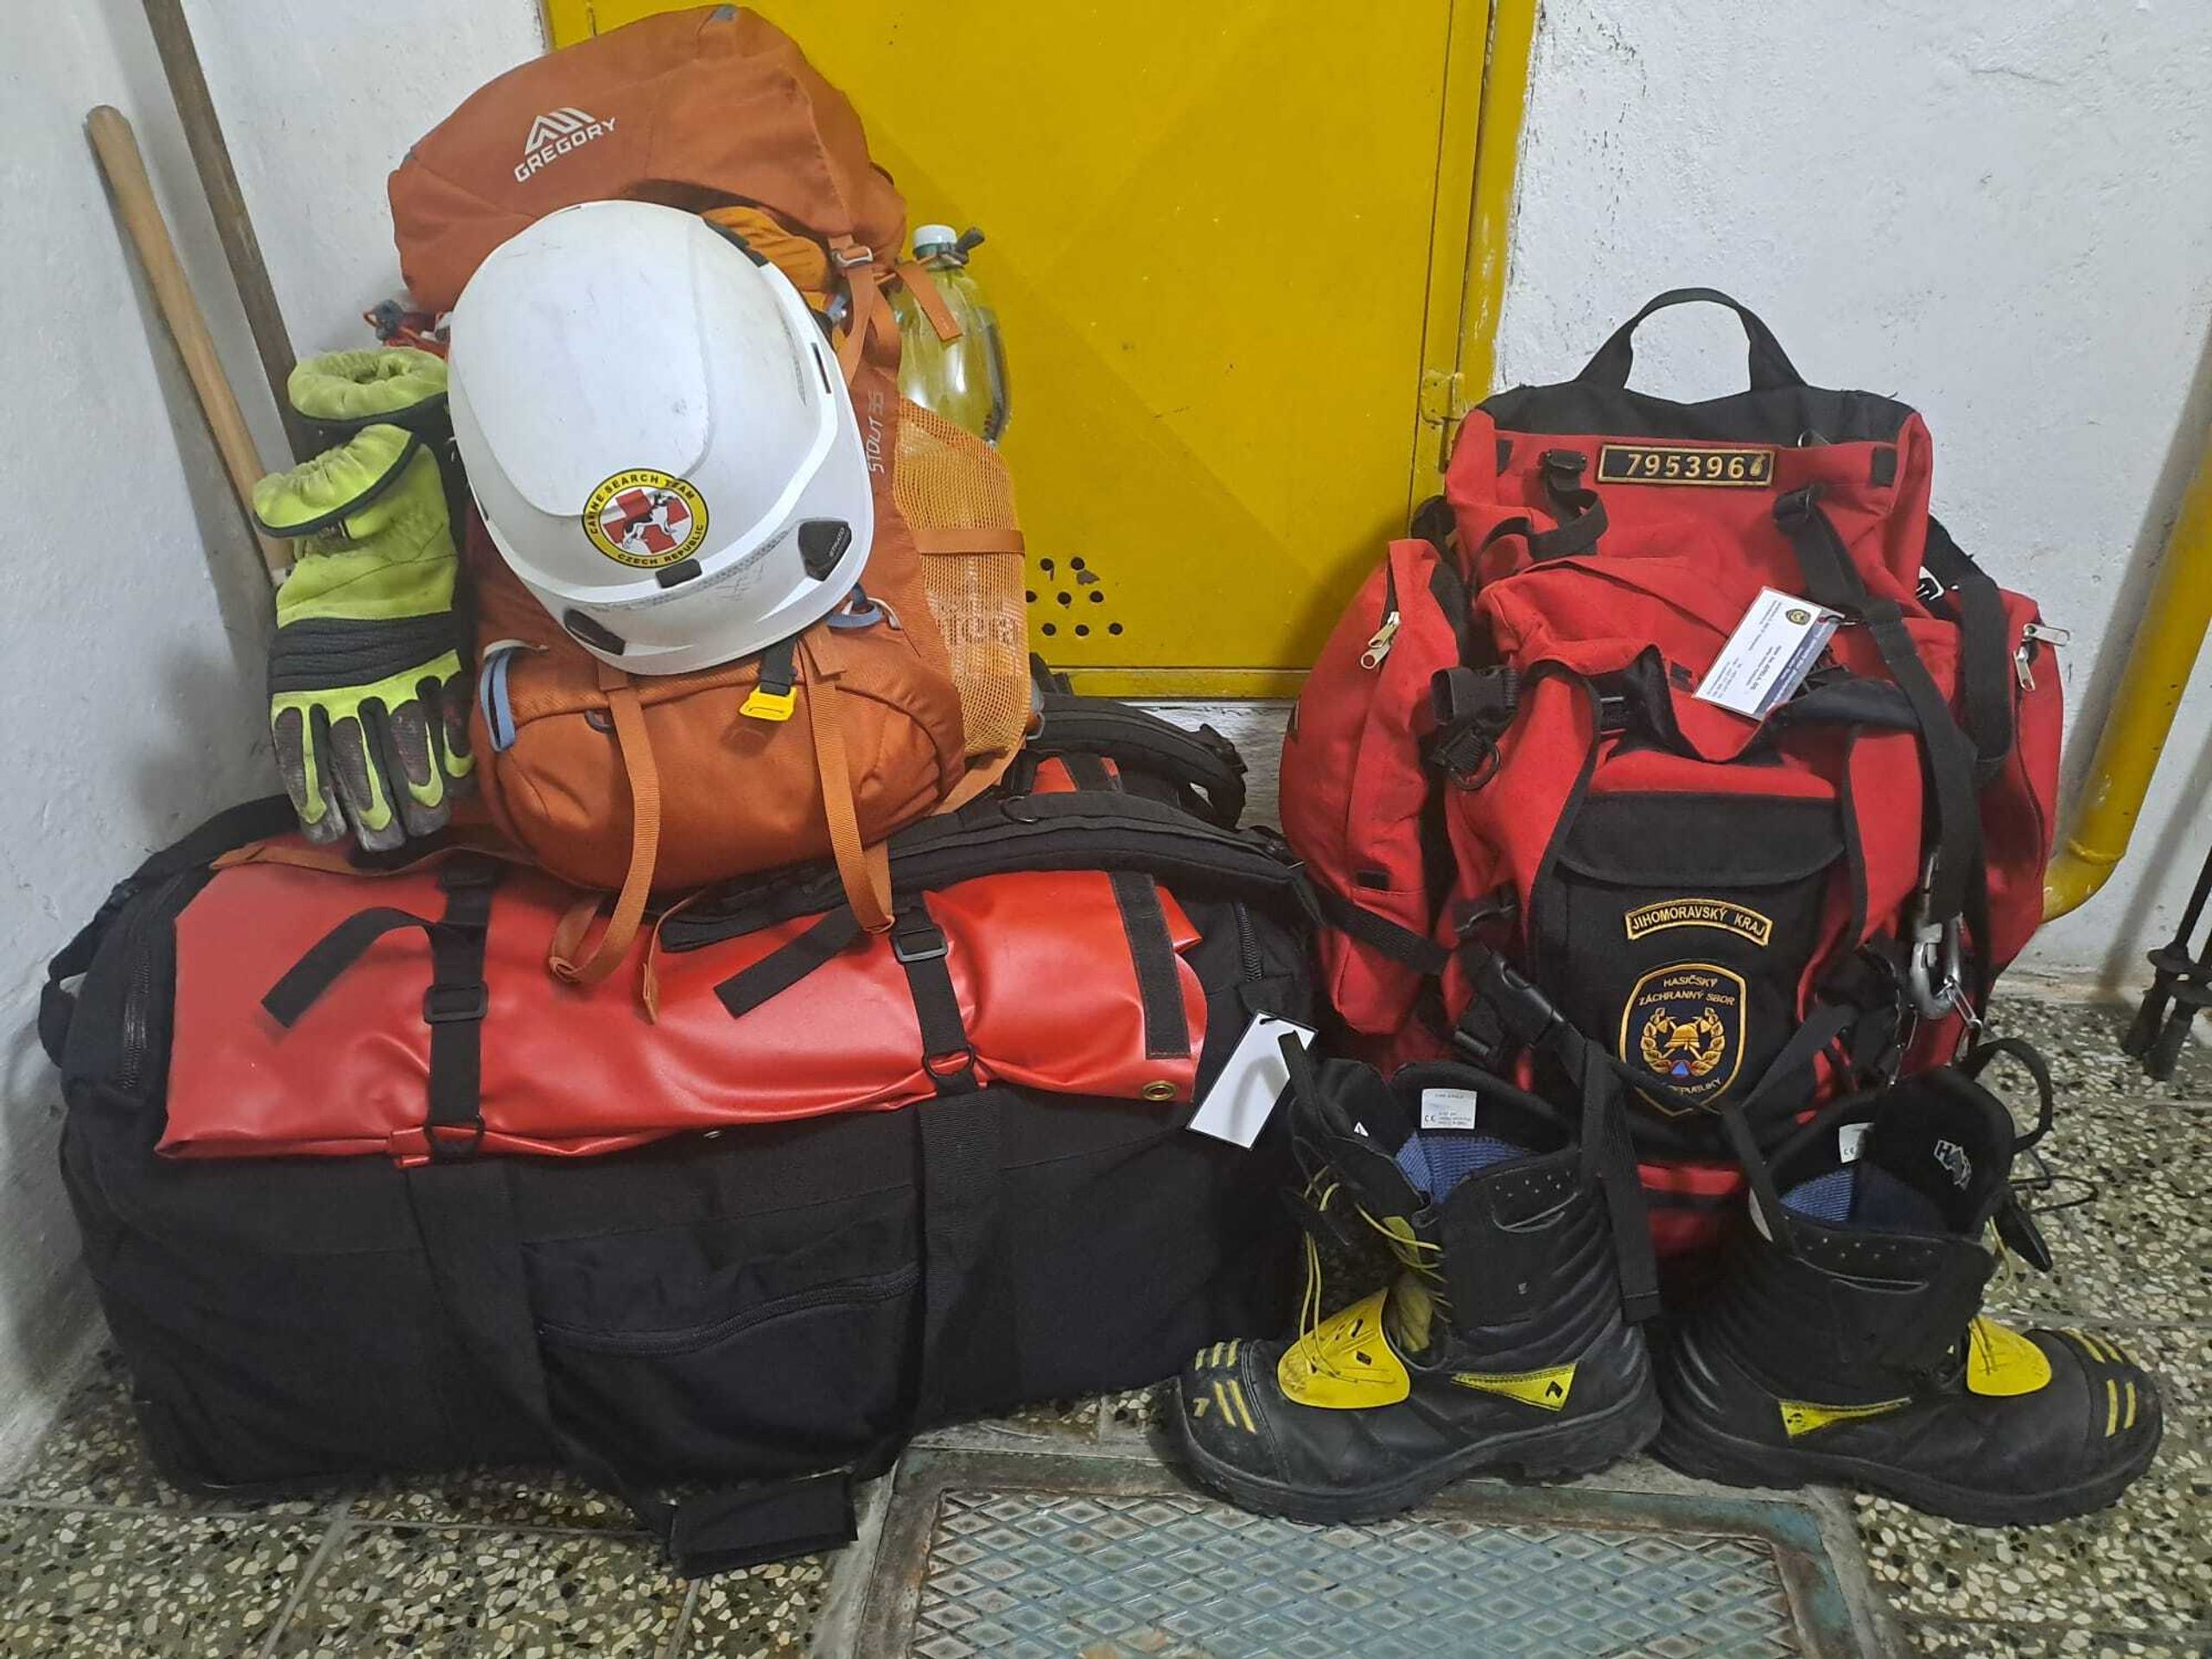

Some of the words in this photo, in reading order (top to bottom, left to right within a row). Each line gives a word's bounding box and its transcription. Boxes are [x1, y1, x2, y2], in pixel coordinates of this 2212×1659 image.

[514, 117, 616, 182] GREGORY
[866, 415, 885, 474] STOUT
[588, 494, 605, 535] CANINE
[604, 473, 659, 494] SEARCH
[664, 479, 696, 500] TEAM
[617, 553, 658, 565] CZECH
[663, 524, 704, 563] REPUBLIC
[1632, 905, 1727, 931] JIHOMORAVSKÝ
[1733, 912, 1766, 937] KRAJ
[1705, 993, 1736, 1007] SBOR
